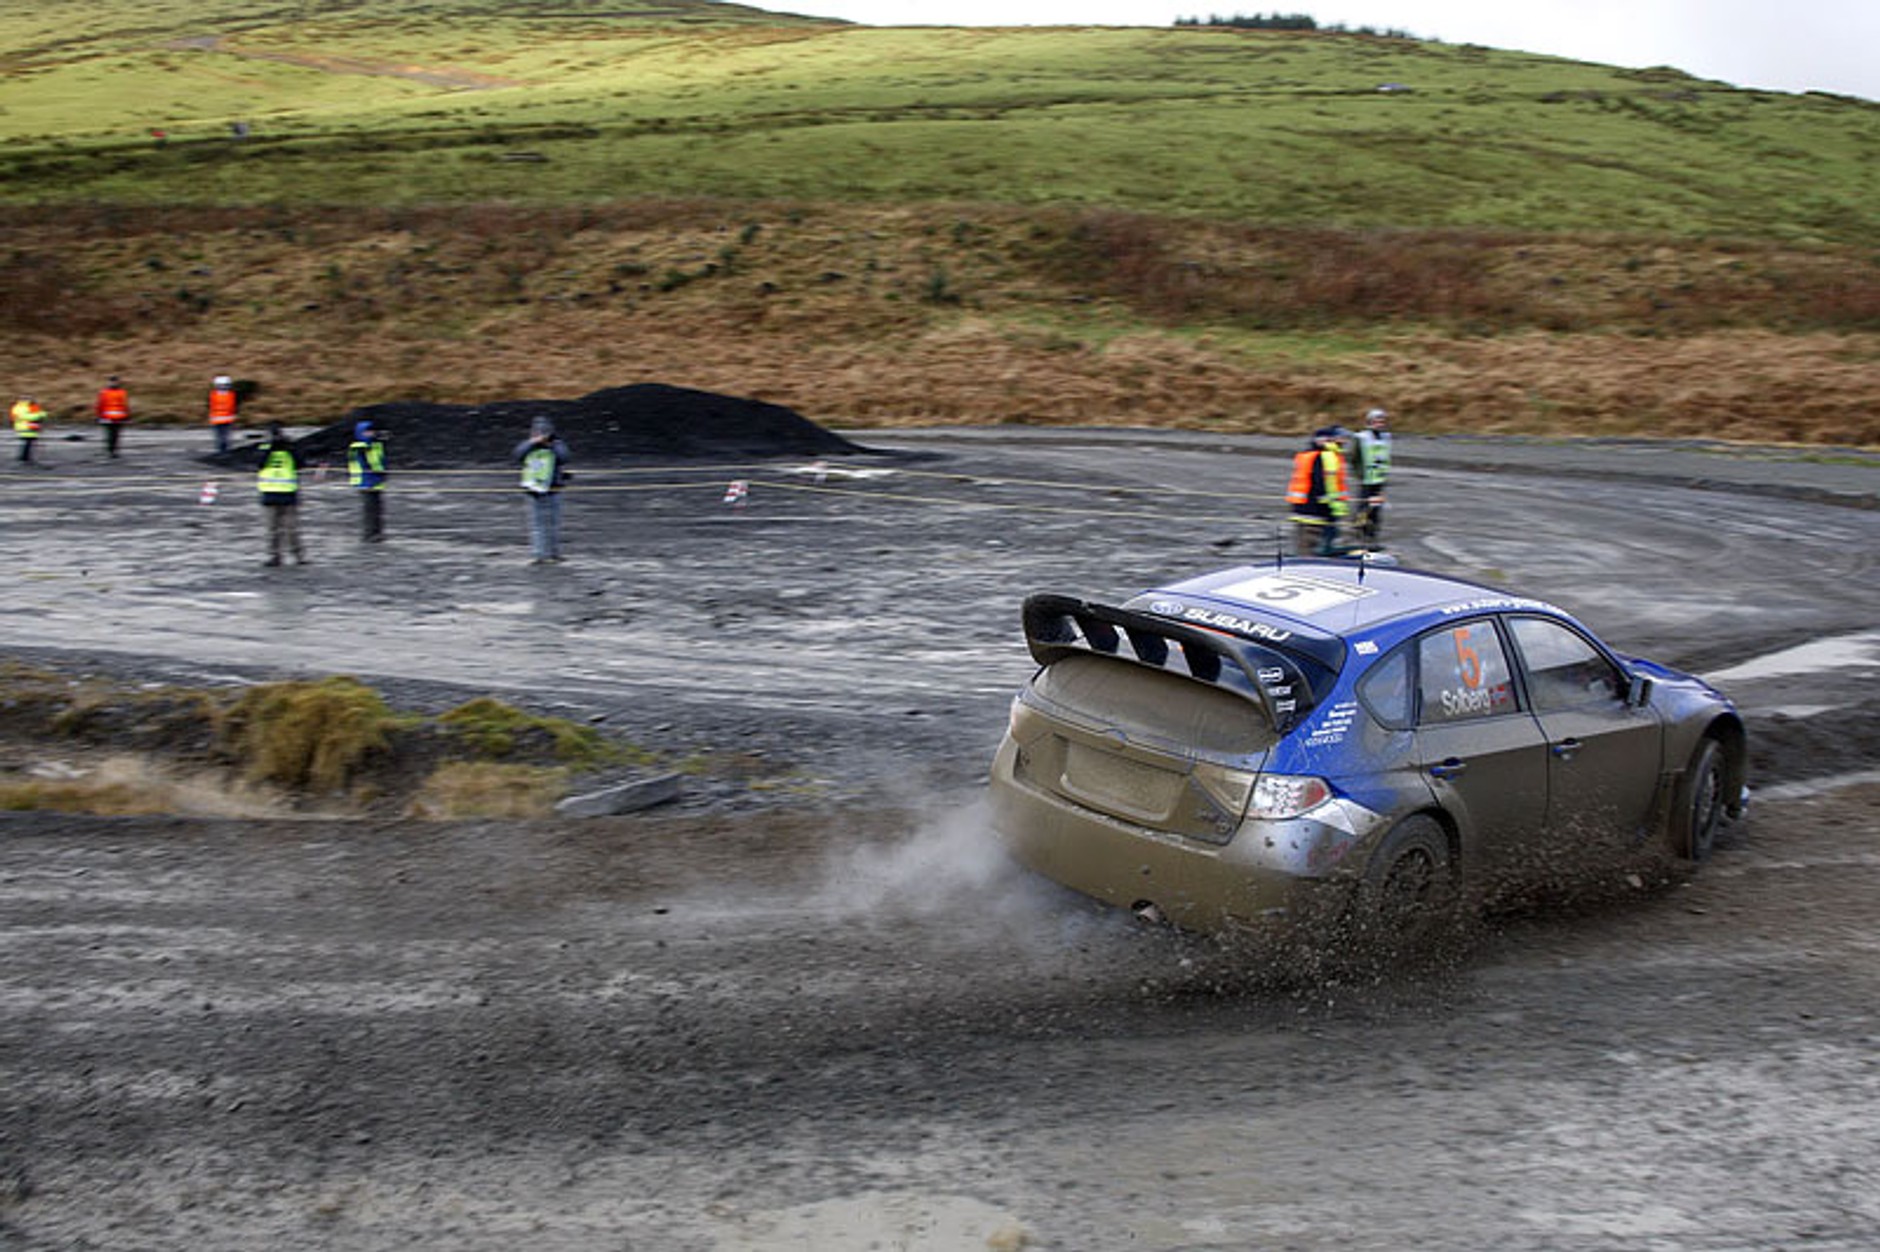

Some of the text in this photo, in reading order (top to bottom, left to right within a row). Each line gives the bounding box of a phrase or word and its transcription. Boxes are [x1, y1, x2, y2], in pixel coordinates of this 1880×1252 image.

[1184, 608, 1292, 642] SUBARU
[1453, 629, 1480, 690] 5
[1442, 687, 1491, 716] Solberg
